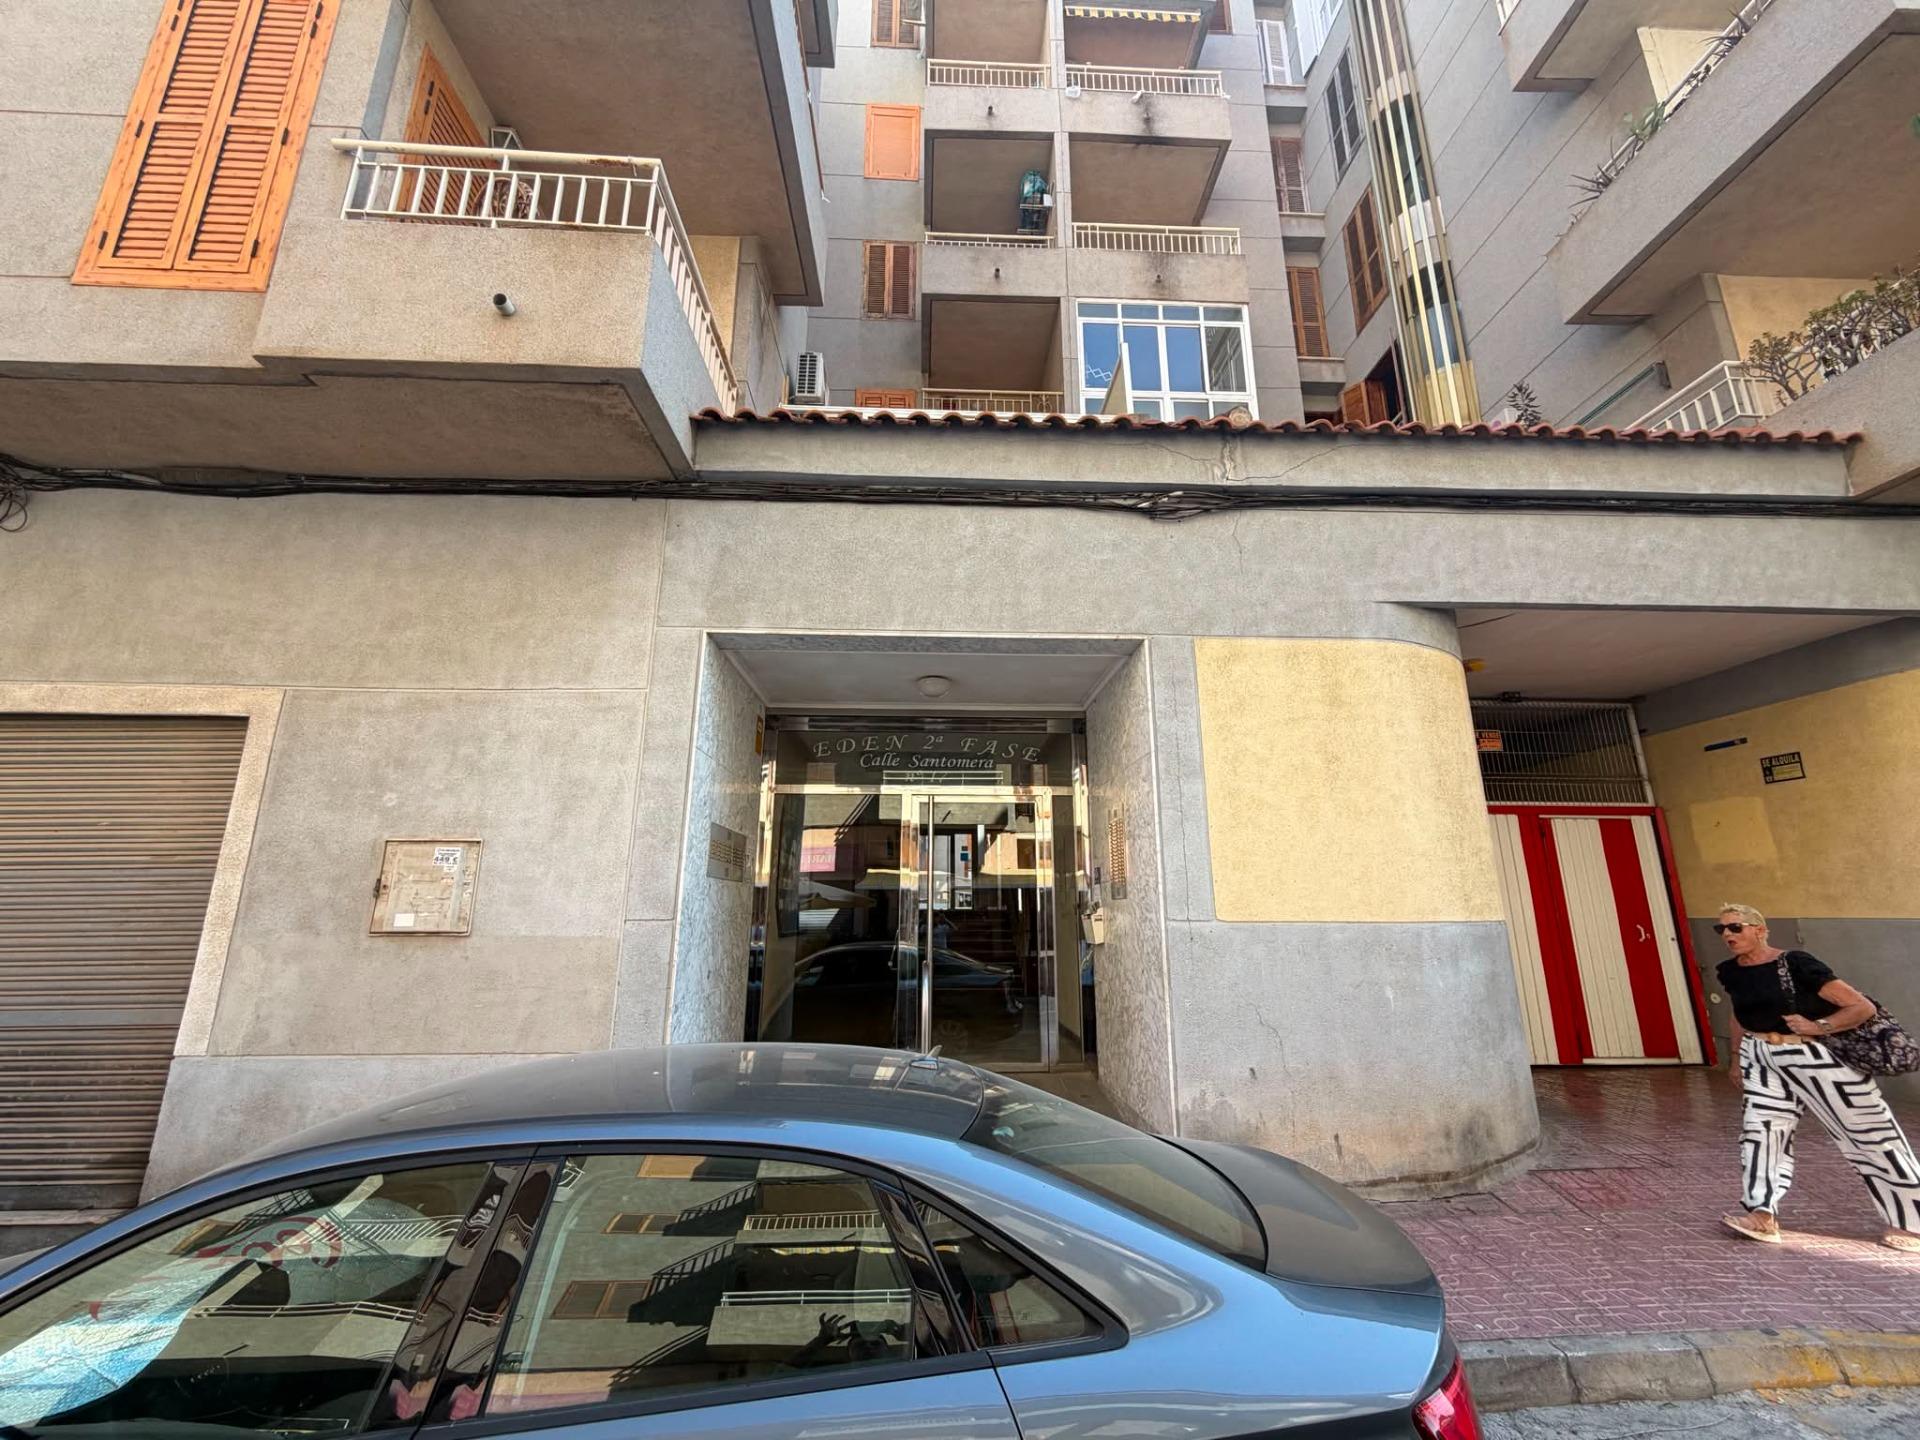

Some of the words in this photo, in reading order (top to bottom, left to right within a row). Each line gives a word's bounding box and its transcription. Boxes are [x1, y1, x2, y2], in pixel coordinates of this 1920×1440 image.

[813, 734, 909, 757] EDEN
[960, 737, 1040, 762] FASE
[860, 752, 900, 768] Calle
[908, 754, 994, 768] Santomera
[1772, 753, 1799, 766] ALQUILA
